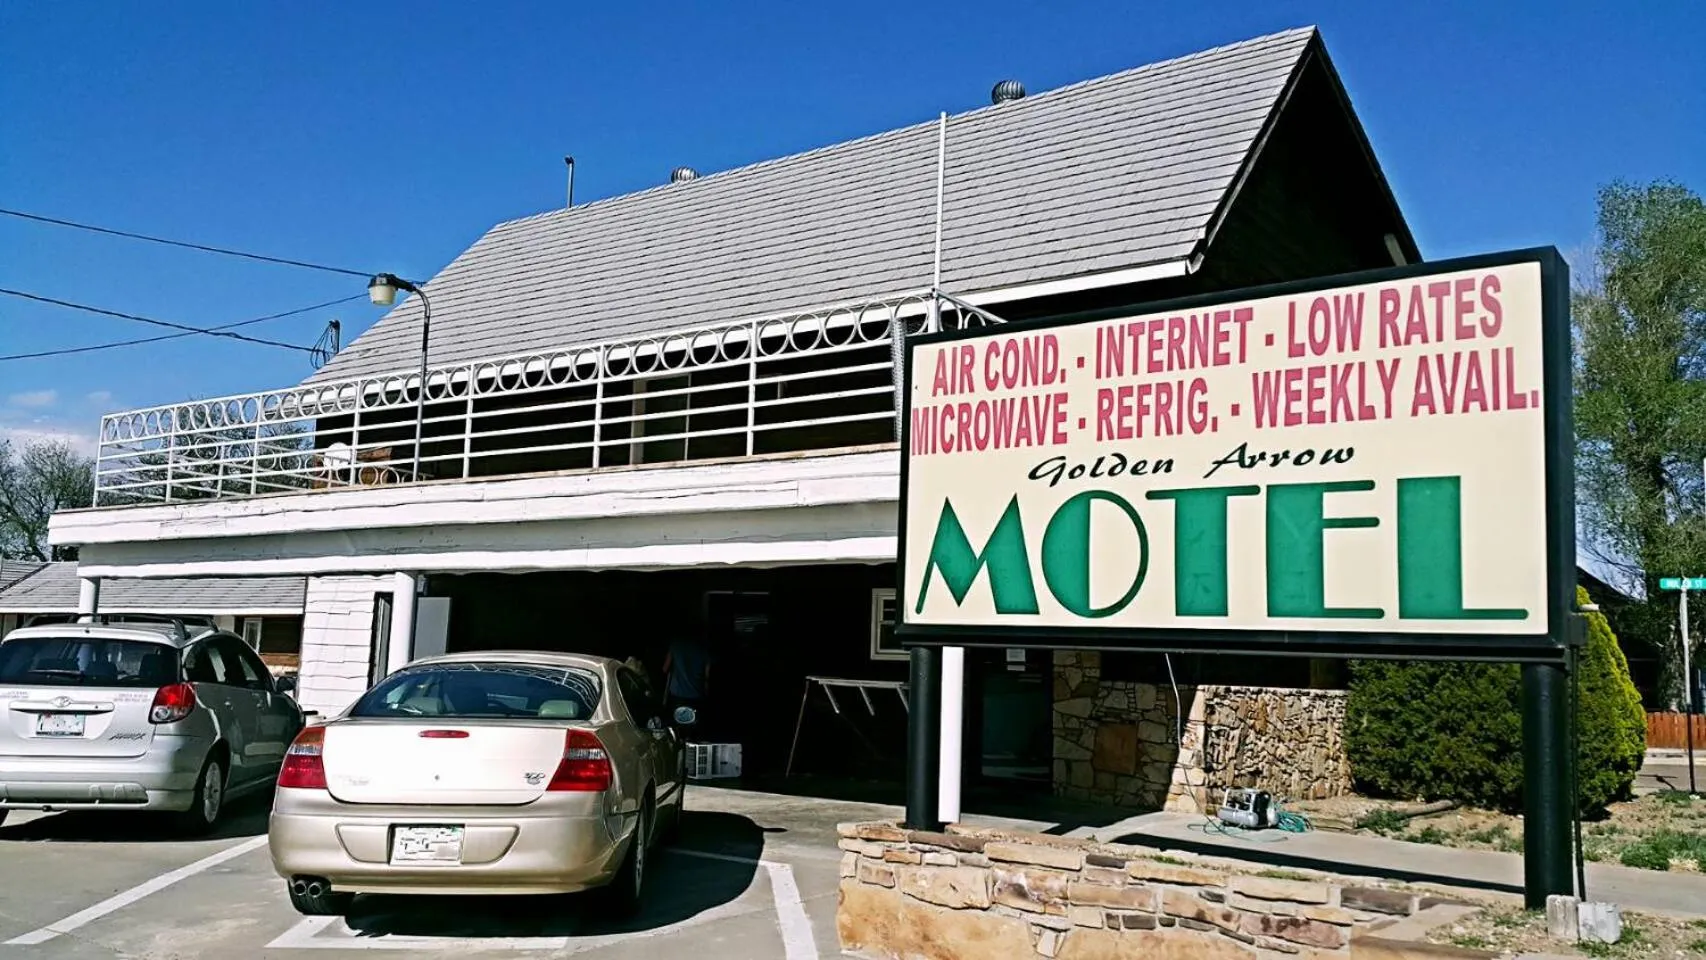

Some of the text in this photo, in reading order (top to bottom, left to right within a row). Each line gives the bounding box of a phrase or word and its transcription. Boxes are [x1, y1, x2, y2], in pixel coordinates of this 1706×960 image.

[933, 276, 1503, 397] AIR COND. INTERNET LOW RATES
[912, 347, 1540, 455] MICROWAVE REFRIG. WEEKLY AVAIL.
[1028, 443, 1354, 488] Golden Arrow
[916, 476, 1529, 620] MOTEL
